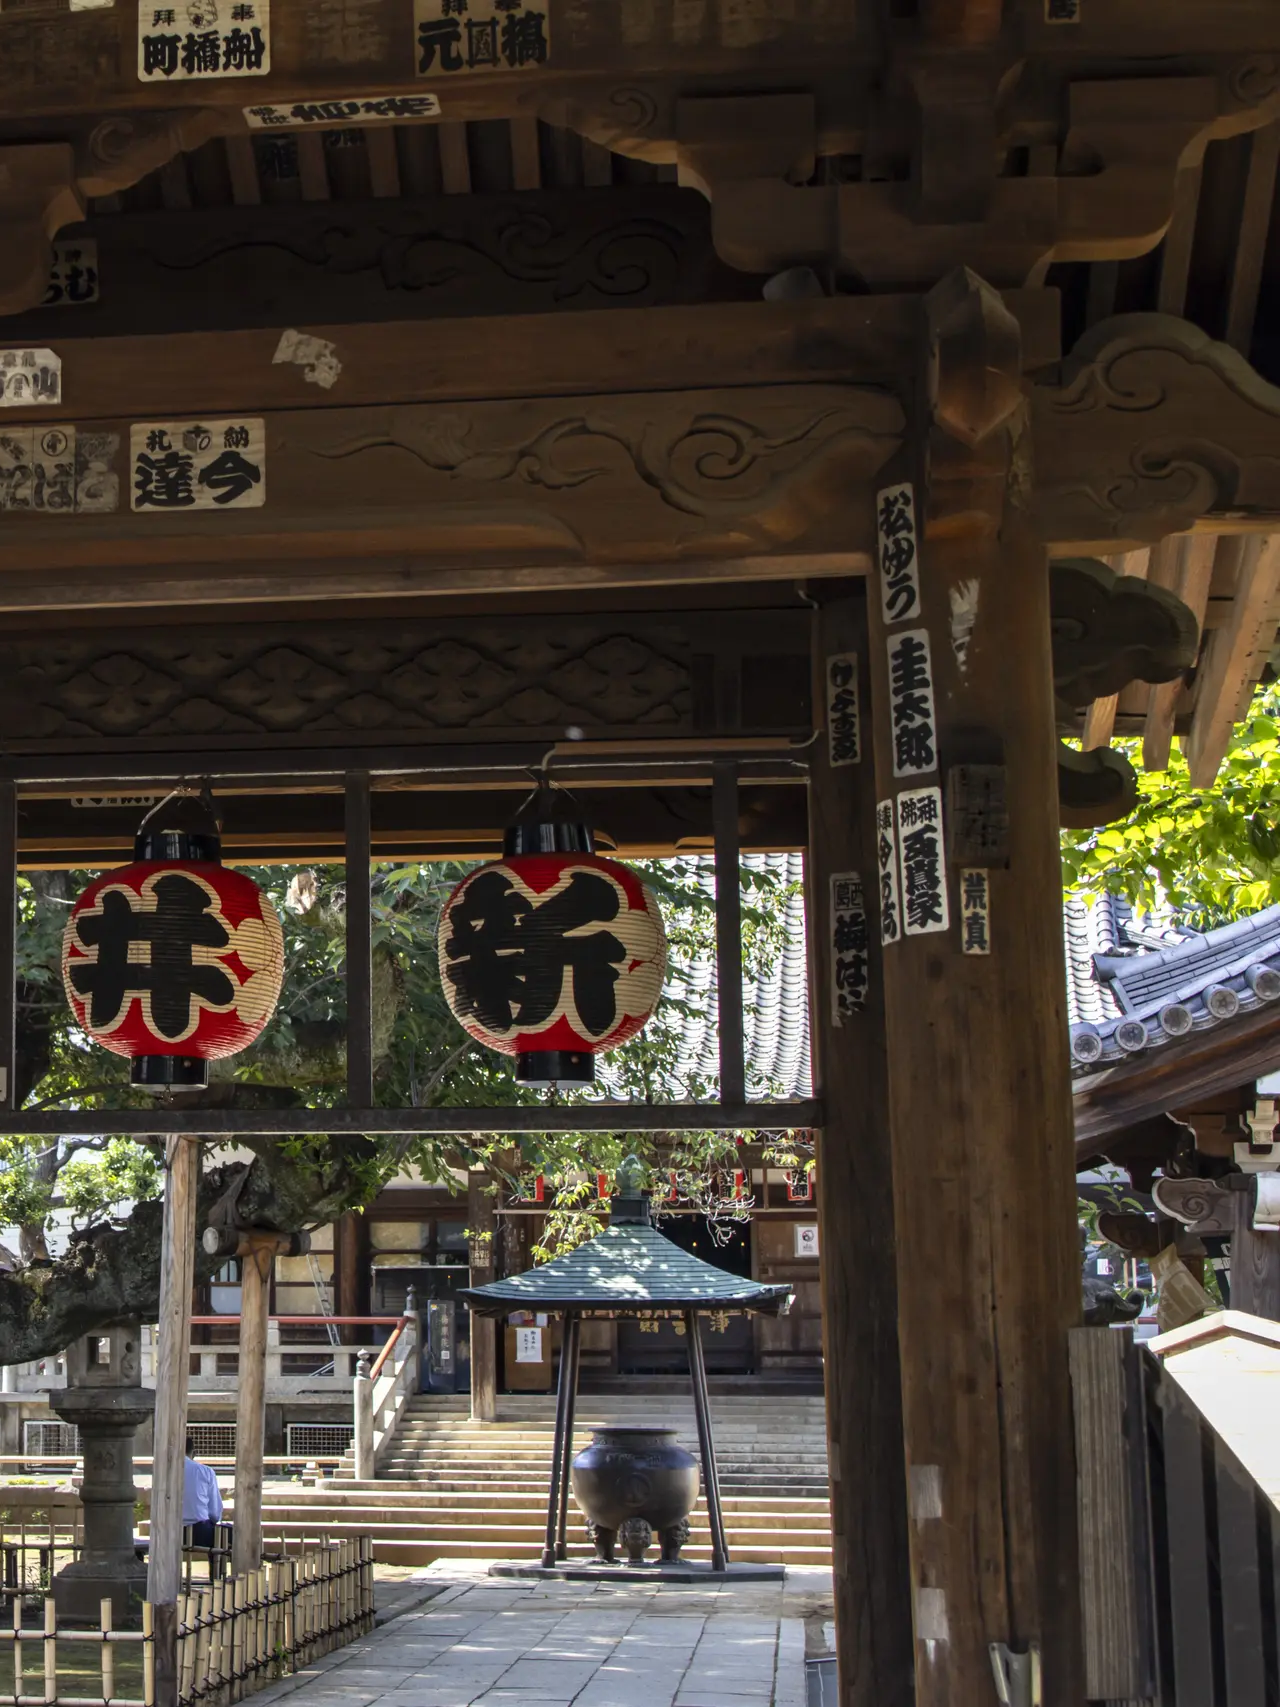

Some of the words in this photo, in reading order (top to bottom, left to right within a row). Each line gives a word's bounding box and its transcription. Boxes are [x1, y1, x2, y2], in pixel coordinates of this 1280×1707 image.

[891, 637, 933, 770] 圭太郎
[70, 875, 235, 1038] 井
[445, 871, 627, 1036] 新
